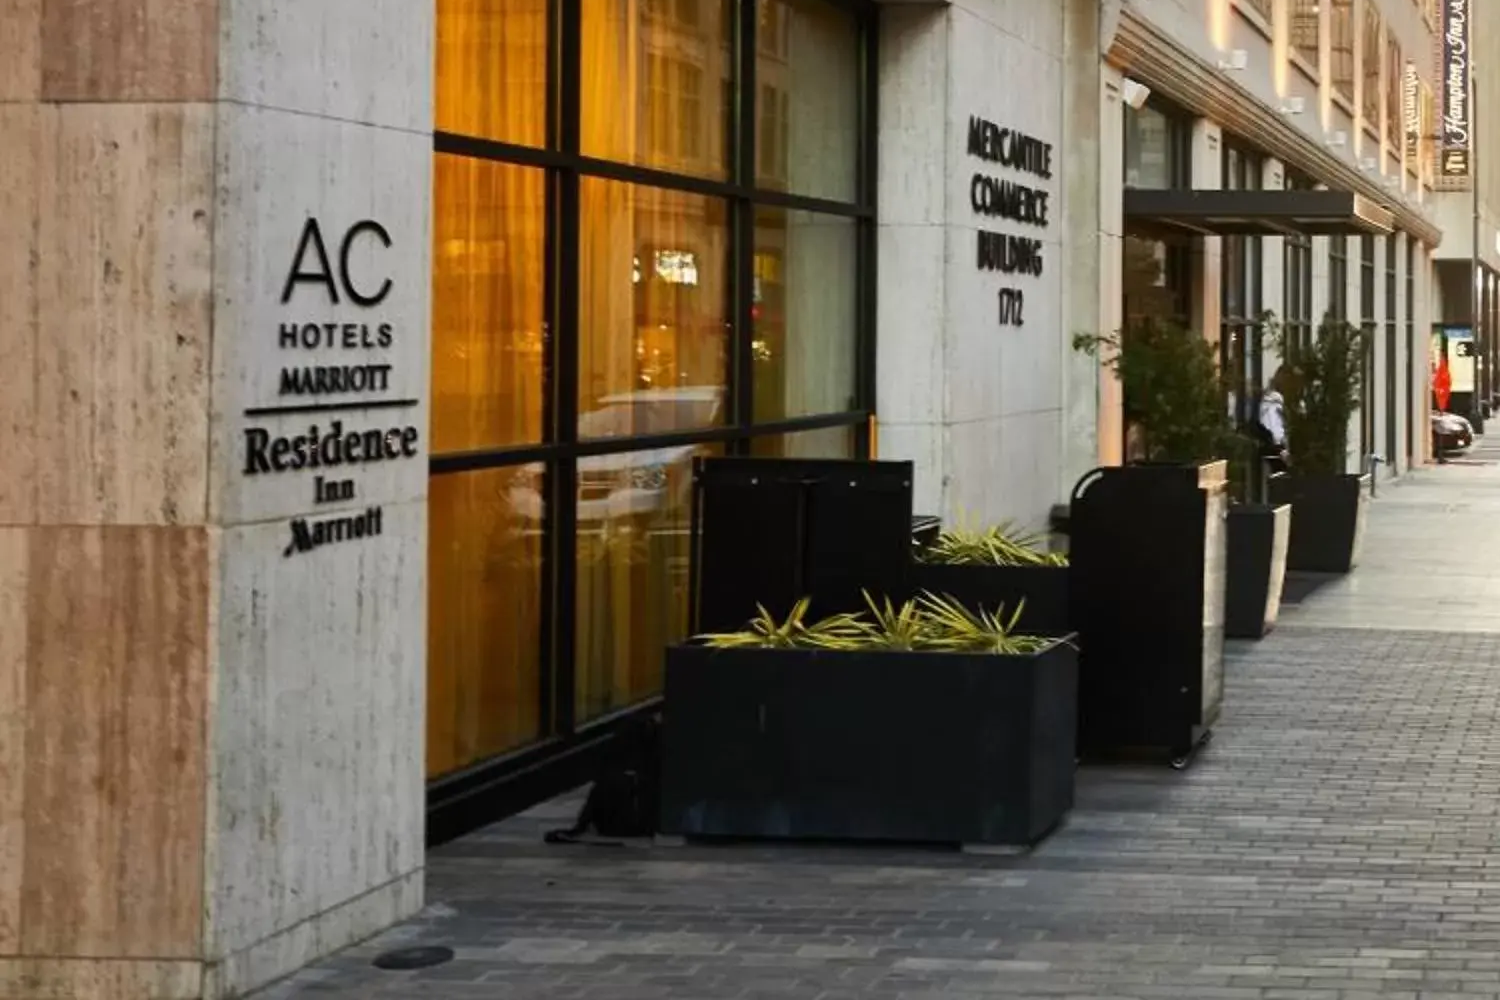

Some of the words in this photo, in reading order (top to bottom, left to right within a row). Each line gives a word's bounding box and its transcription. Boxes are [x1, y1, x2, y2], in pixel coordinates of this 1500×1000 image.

[1445, 11, 1466, 54] Inn
[1444, 56, 1468, 145] Hampton
[966, 113, 1053, 180] MERCANTILE
[970, 173, 1049, 227] COMMERCE
[280, 216, 394, 308] AC
[976, 229, 1043, 278] BUILDING
[998, 287, 1025, 328] 1712
[279, 322, 394, 350] HOTELS
[277, 364, 393, 396] MARRIOTT
[242, 421, 418, 477] Residence
[313, 475, 355, 505] Inn
[283, 506, 383, 559] Marriott
